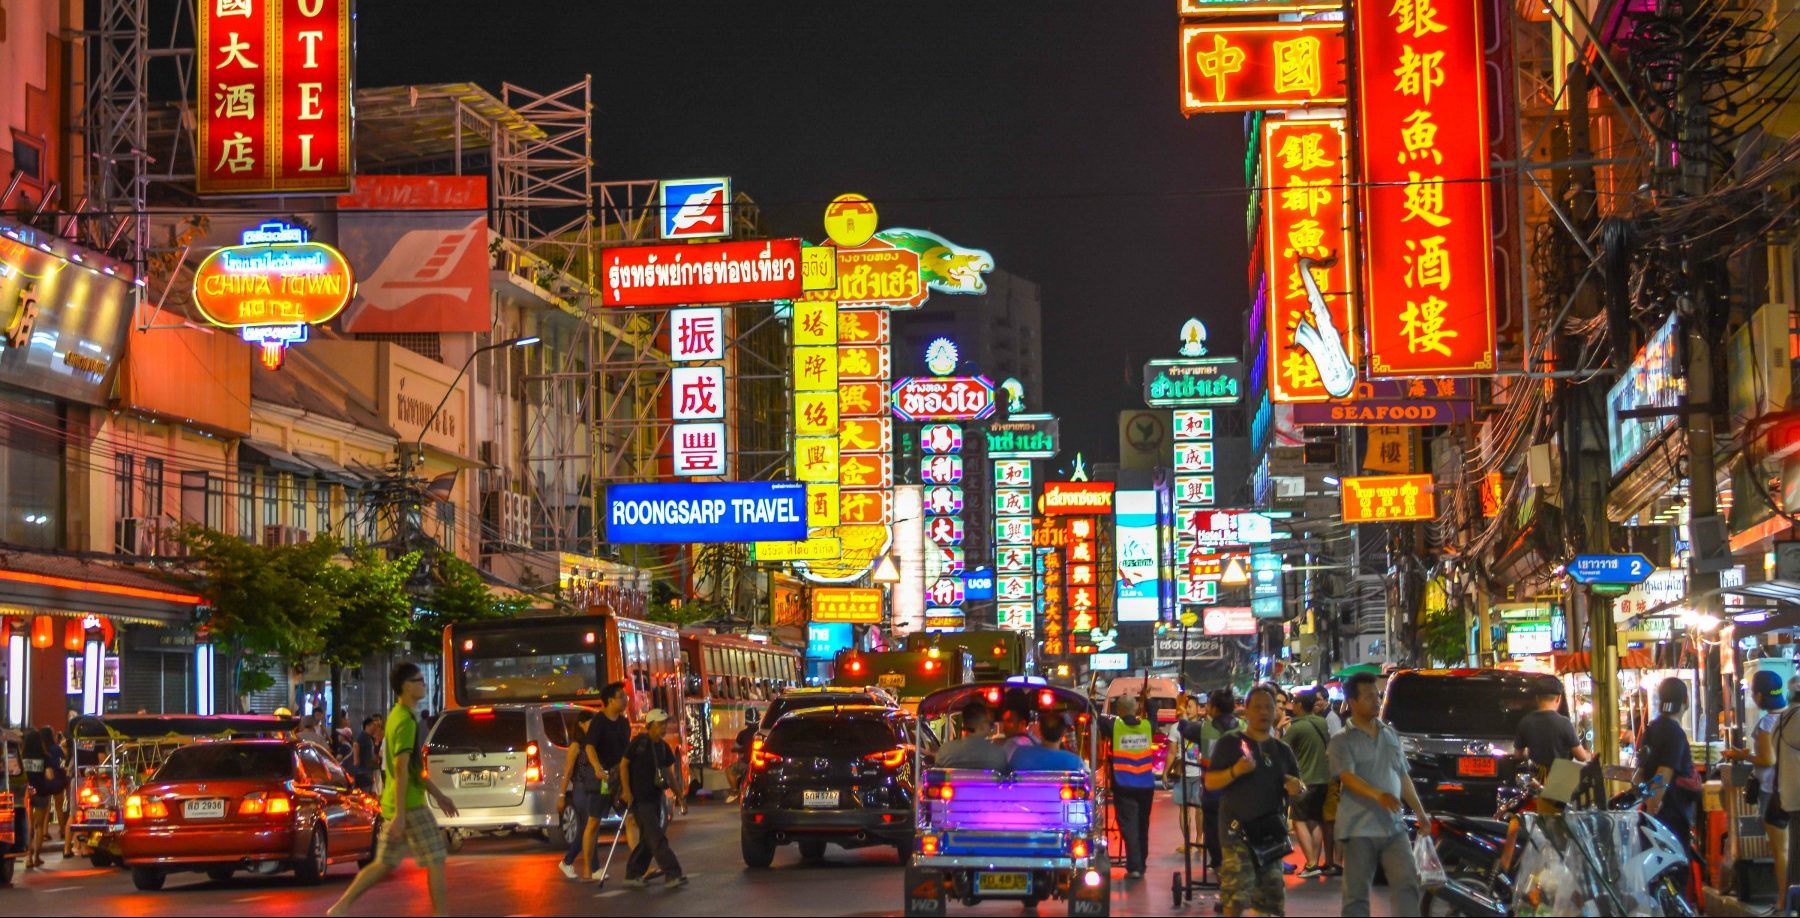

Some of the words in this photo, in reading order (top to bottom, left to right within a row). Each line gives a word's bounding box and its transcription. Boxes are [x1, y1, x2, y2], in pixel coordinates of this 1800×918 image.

[1197, 34, 1321, 102] 中國
[1389, 0, 1458, 357] 銀都魚翅酒樓
[609, 242, 795, 301] รุ่งทรัพย์การท่องเที่ยว
[205, 274, 271, 296] CHINA
[281, 274, 341, 296] TOWN
[239, 299, 305, 318] HOTEL
[678, 317, 719, 471] 振成豐
[1331, 405, 1437, 420] SEAFOOD
[612, 499, 726, 525] ROONGSARP
[731, 498, 800, 524] TRAVEL
[1578, 558, 1618, 569] เยาวราช
[1630, 560, 1641, 576] 2
[967, 578, 992, 589] UOB
[202, 800, 222, 810] 2936
[911, 899, 939, 911] WD
